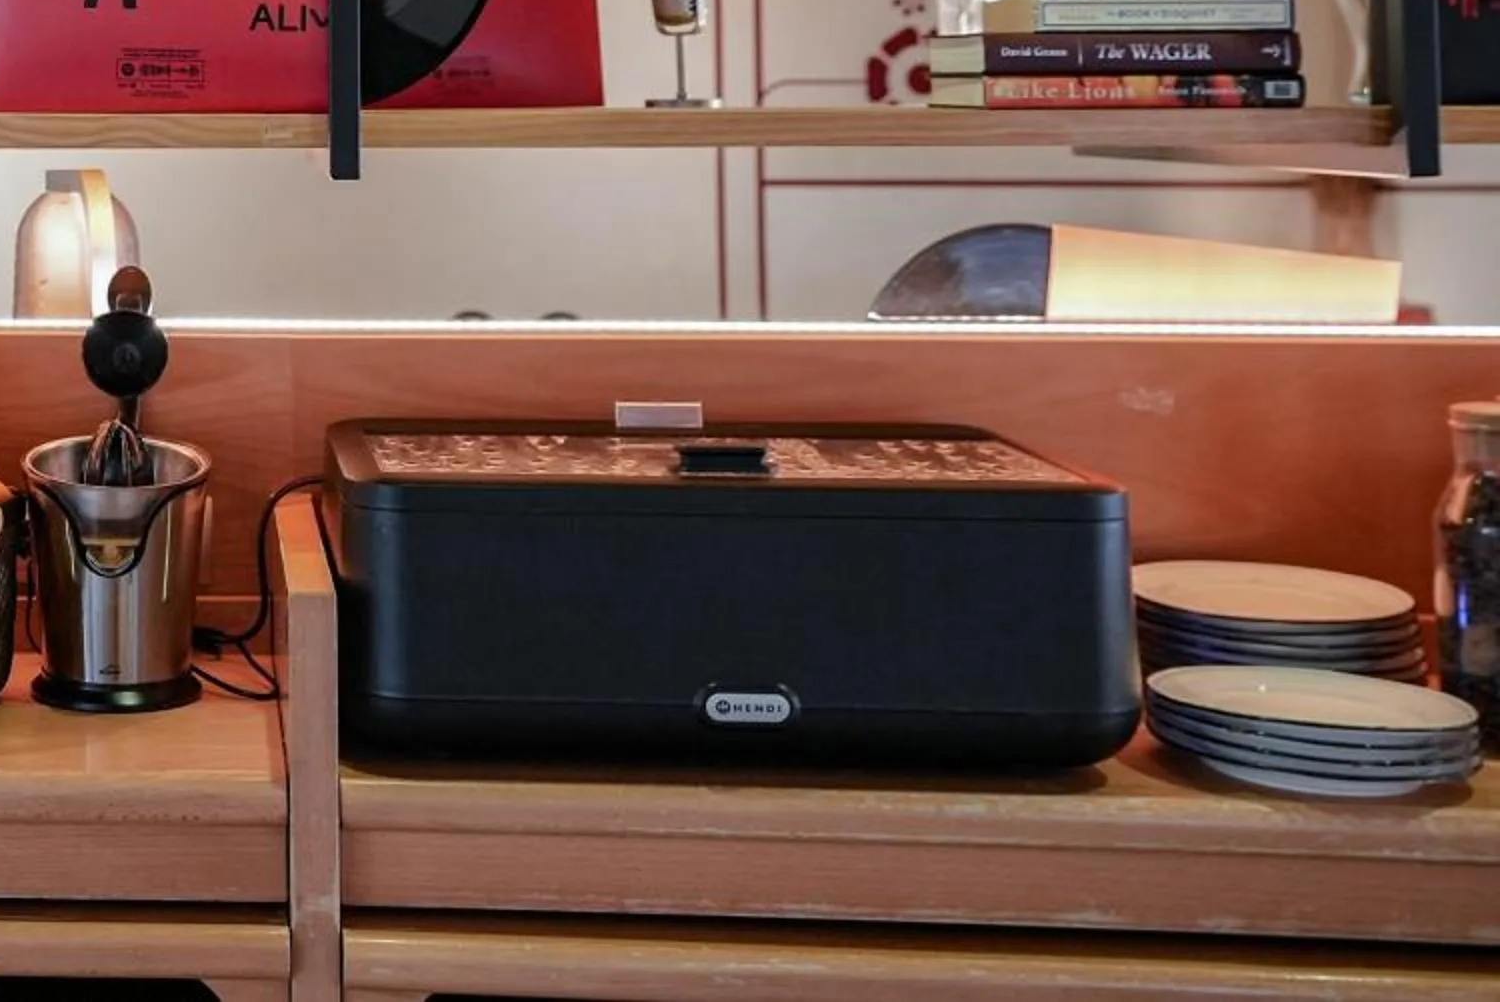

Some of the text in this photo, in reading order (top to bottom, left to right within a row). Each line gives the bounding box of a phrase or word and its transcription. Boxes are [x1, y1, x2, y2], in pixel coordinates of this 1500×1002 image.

[249, 3, 329, 31] ALIV
[1001, 46, 1031, 57] David
[1095, 43, 1126, 59] The
[1128, 42, 1213, 61] WAGER
[732, 703, 782, 713] HENDI
